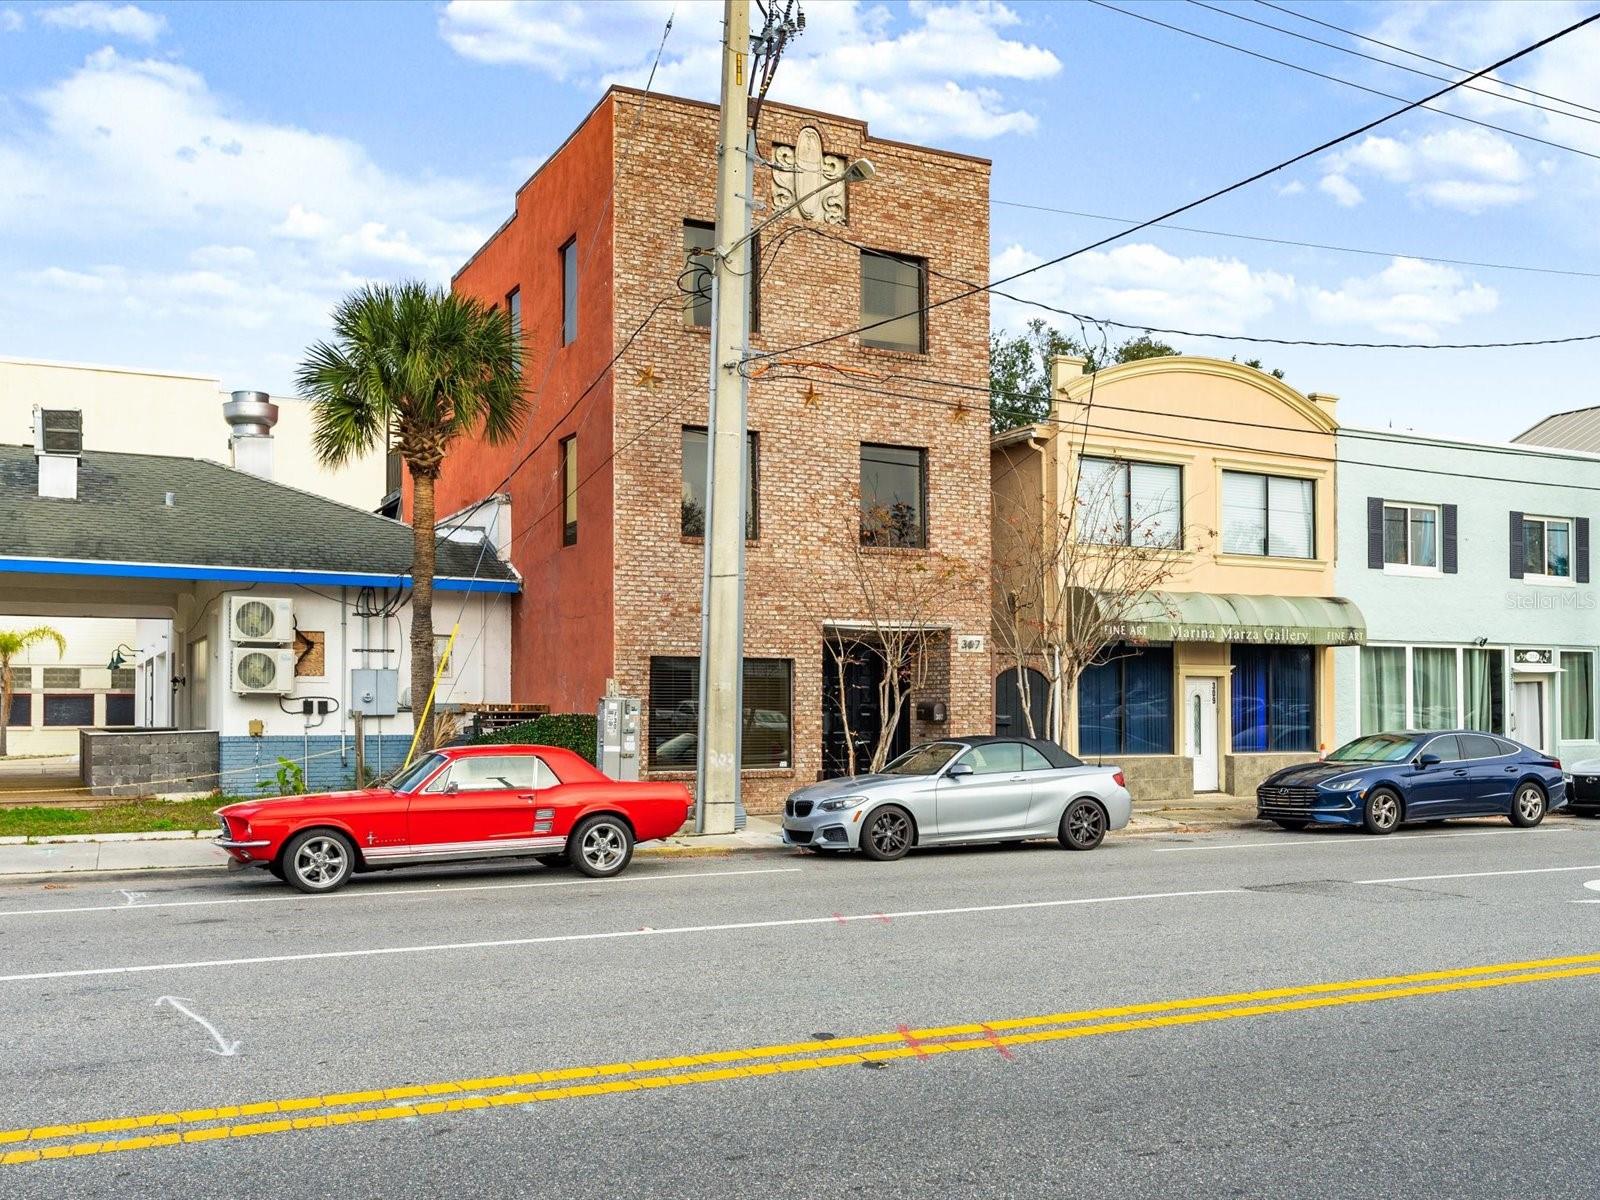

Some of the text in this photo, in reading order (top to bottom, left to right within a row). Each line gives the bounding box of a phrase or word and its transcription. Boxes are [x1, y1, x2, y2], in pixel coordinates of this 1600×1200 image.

[1104, 625, 1148, 636] FINE ART
[1169, 625, 1309, 644] Marina Marza Gallery
[1326, 630, 1364, 641] FINE ART
